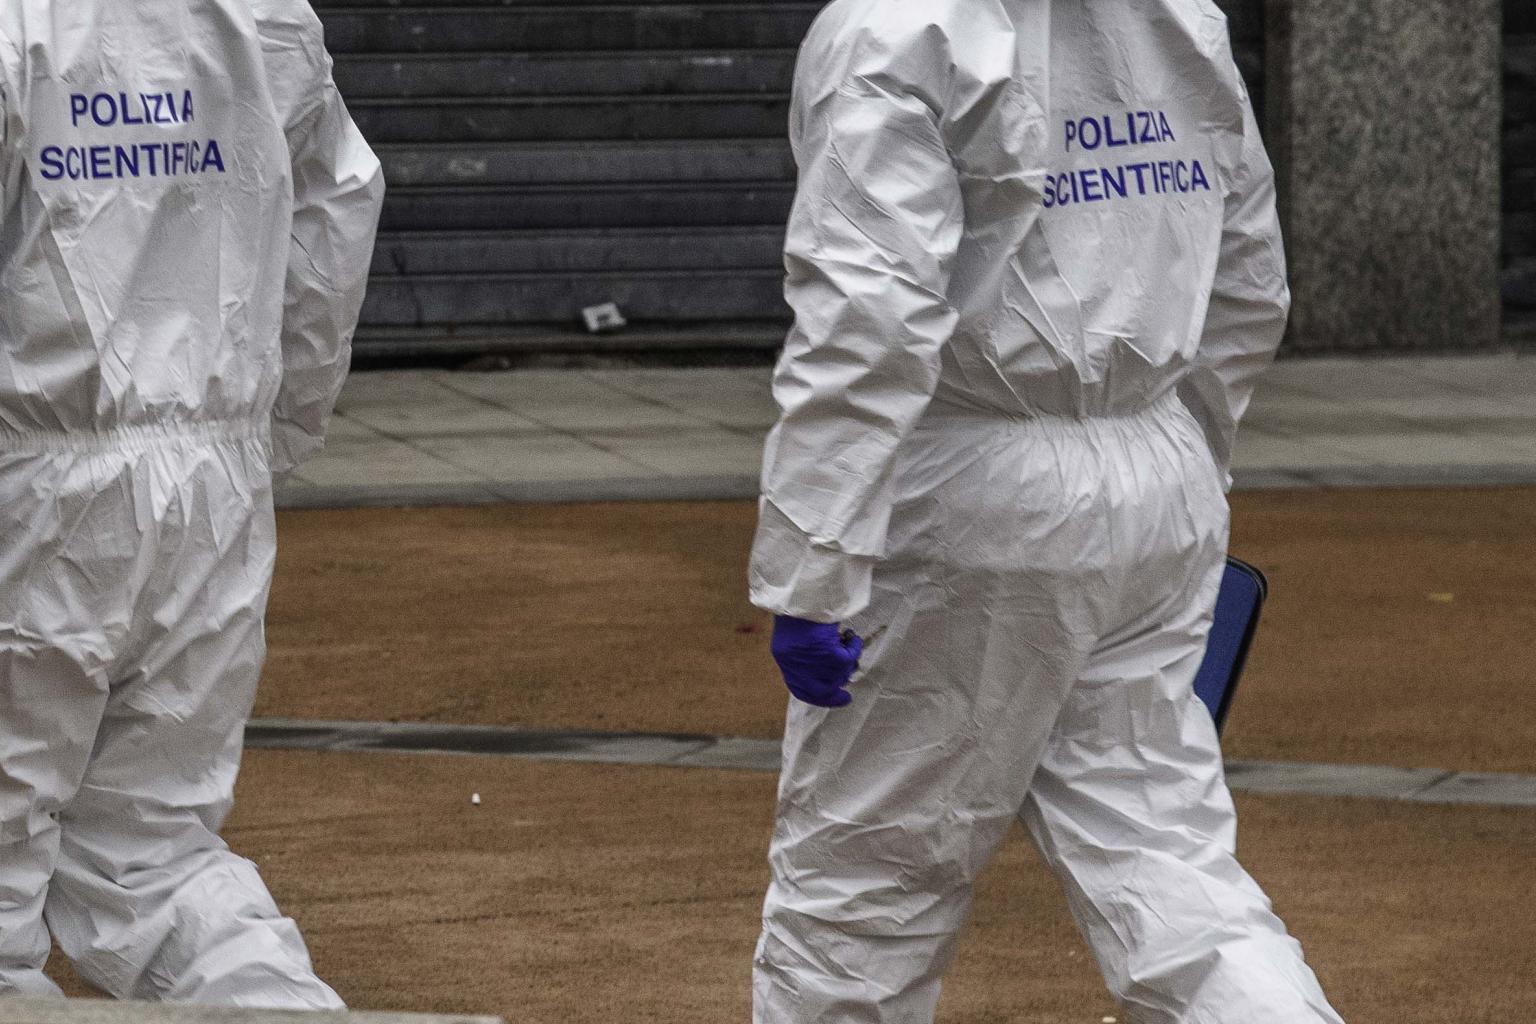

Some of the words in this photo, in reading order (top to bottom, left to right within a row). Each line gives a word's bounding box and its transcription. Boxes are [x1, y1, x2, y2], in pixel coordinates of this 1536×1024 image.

[69, 88, 196, 127] POLIZIA
[1064, 110, 1177, 152] POLIZIA
[39, 138, 226, 180] SCIENTIFICA
[1041, 159, 1211, 209] SCIENTIFICA
